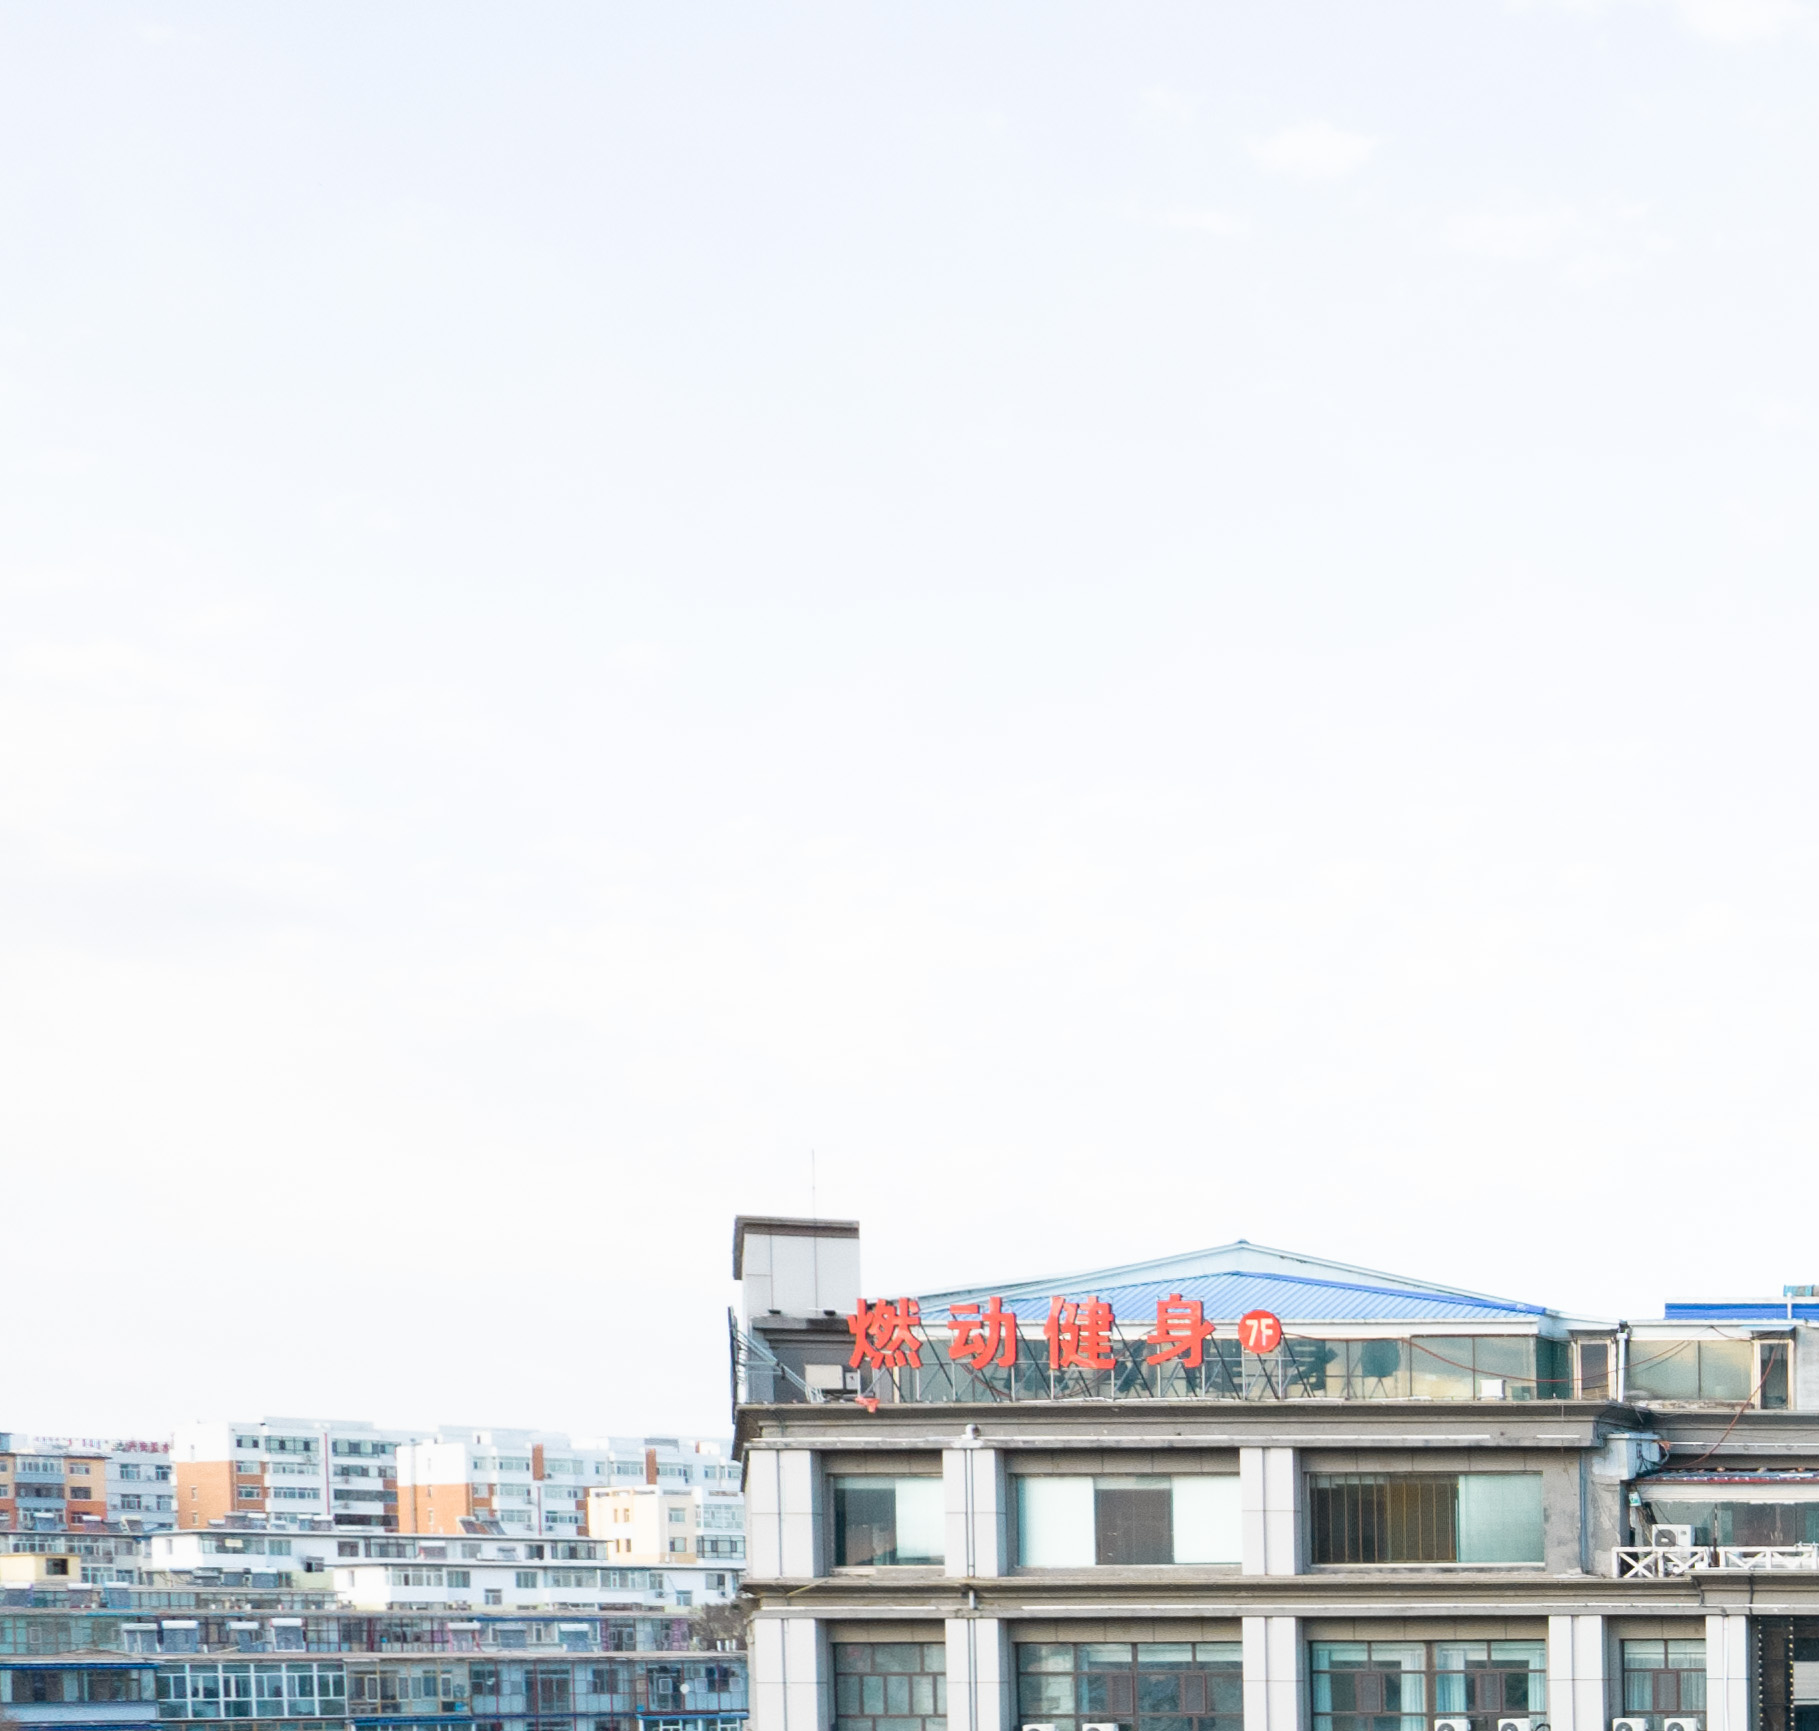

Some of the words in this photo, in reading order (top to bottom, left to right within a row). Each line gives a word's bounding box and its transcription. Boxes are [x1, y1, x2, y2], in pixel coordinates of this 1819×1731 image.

[848, 1294, 1215, 1369] 燃动健身
[1246, 1319, 1275, 1350] 7F
